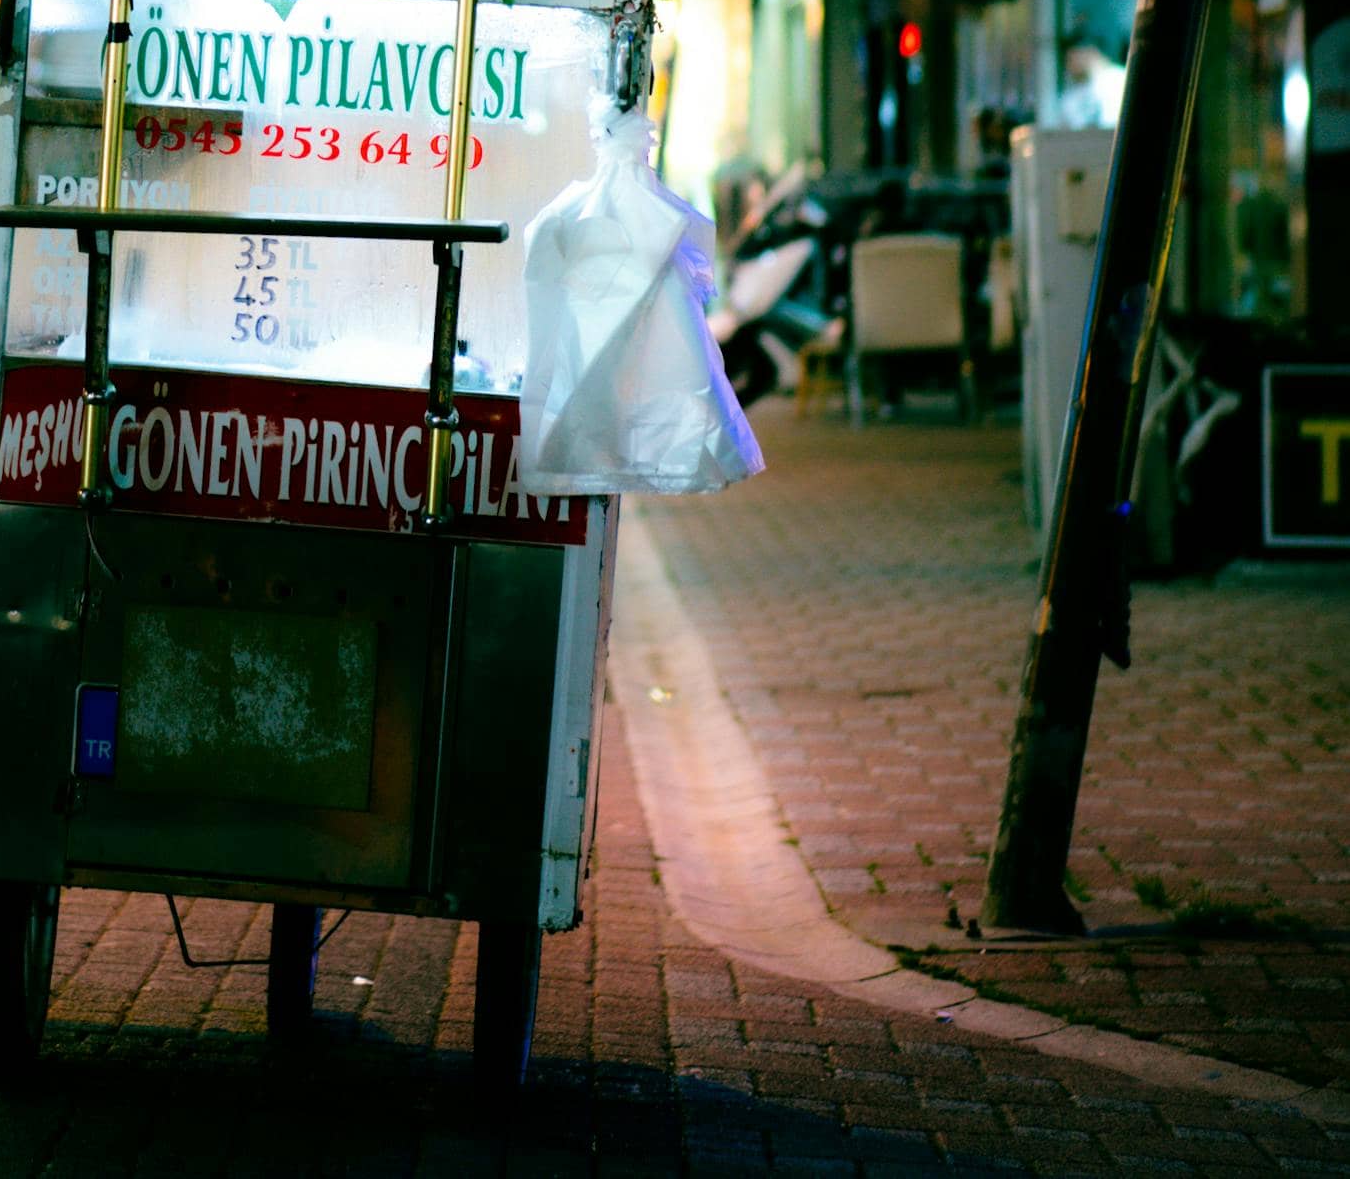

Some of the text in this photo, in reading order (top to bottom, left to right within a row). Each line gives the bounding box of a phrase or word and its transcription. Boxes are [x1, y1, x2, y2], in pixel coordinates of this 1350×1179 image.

[285, 16, 529, 119] PİLAVCSI
[135, 116, 244, 156] 0545
[262, 123, 341, 162] 253
[359, 130, 412, 166] 64
[36, 170, 190, 210] PORİYON
[234, 235, 281, 270] 35
[287, 240, 319, 271] TL
[233, 275, 280, 307] 45
[287, 279, 318, 309] TL
[230, 312, 280, 346] 50
[287, 318, 319, 350] TL
[107, 380, 267, 500] GÖNEN
[85, 739, 112, 760] TR
